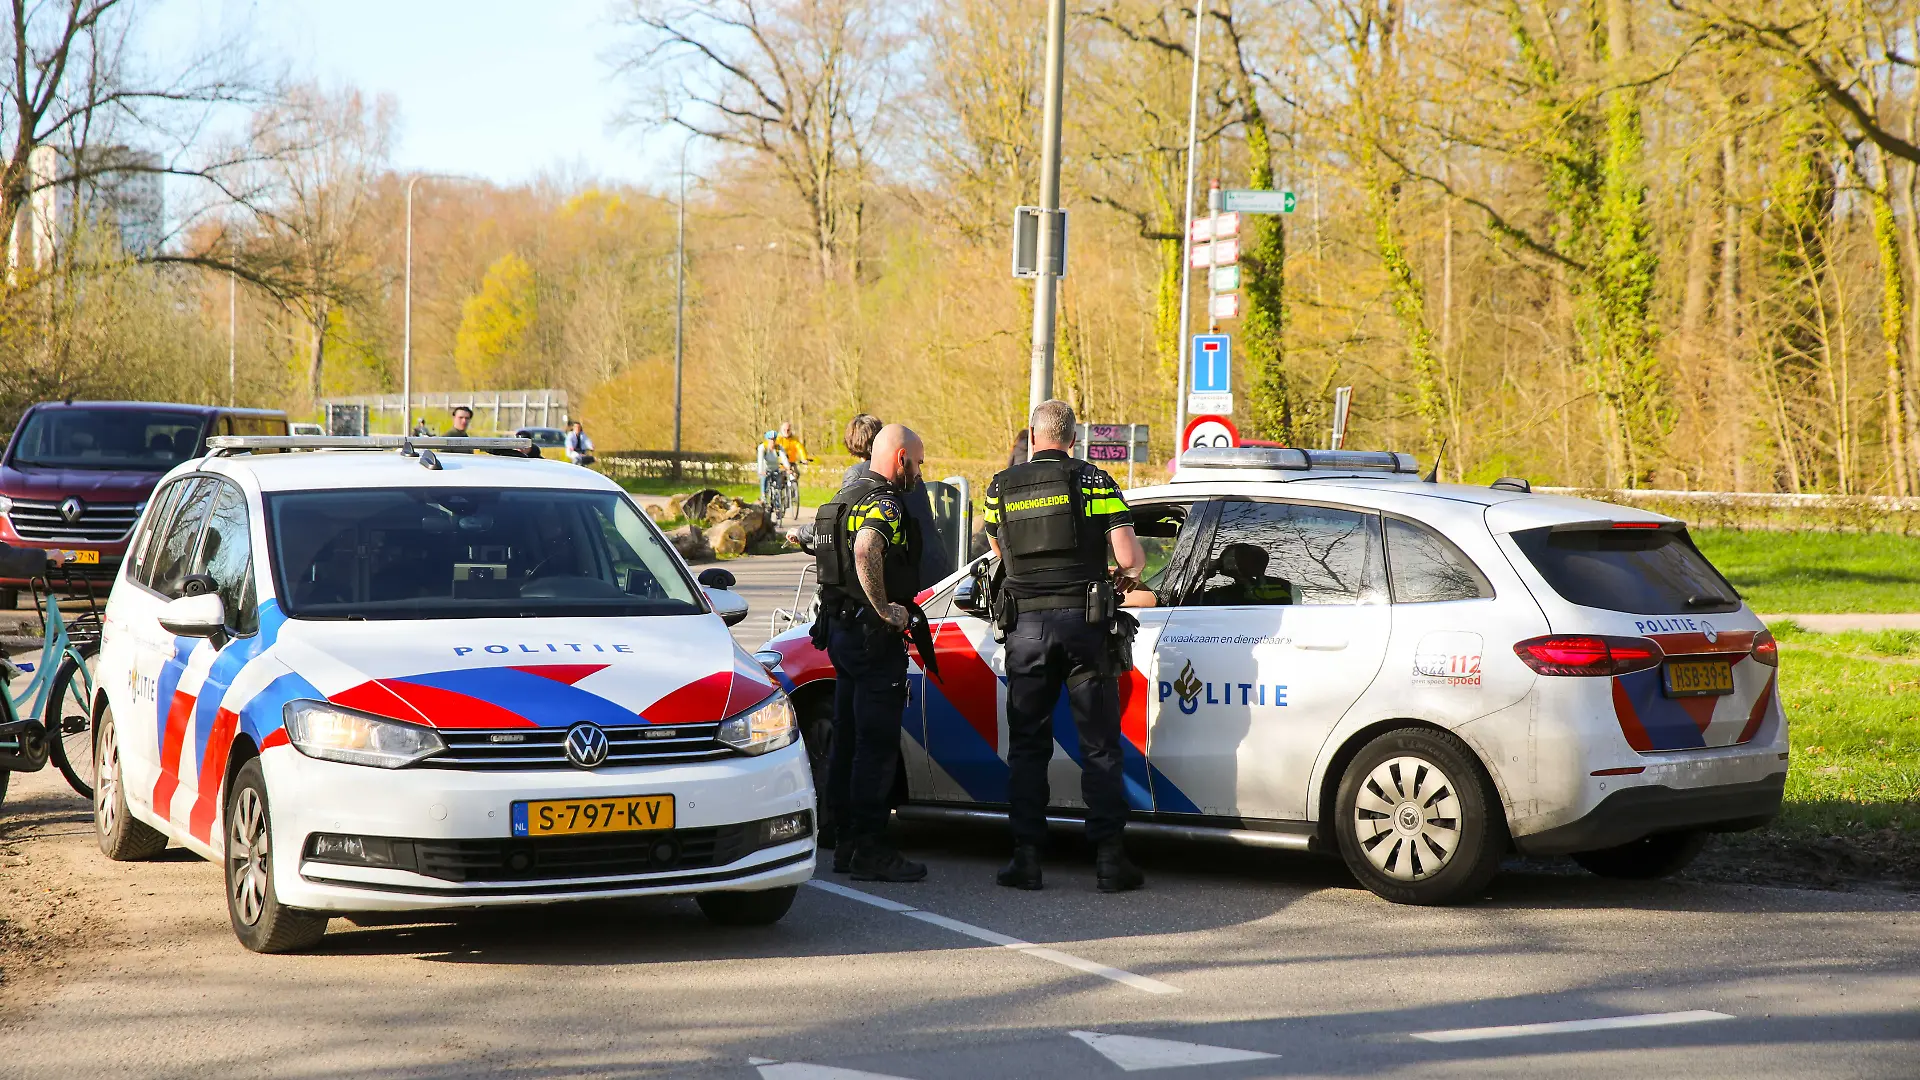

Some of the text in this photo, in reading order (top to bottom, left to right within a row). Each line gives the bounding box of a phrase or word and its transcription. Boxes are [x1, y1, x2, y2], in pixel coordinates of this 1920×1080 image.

[1005, 494, 1070, 512] HONDENGELEIDER
[1635, 619, 1697, 633] POLITIE
[1234, 634, 1284, 644] dienstbaar
[453, 643, 634, 656] POLITIE
[1450, 655, 1482, 673] 112
[127, 668, 155, 704] POLITIE
[1447, 675, 1481, 687] spoed
[1158, 681, 1288, 714] POLITIE
[515, 800, 661, 831] NL S-797-KV
